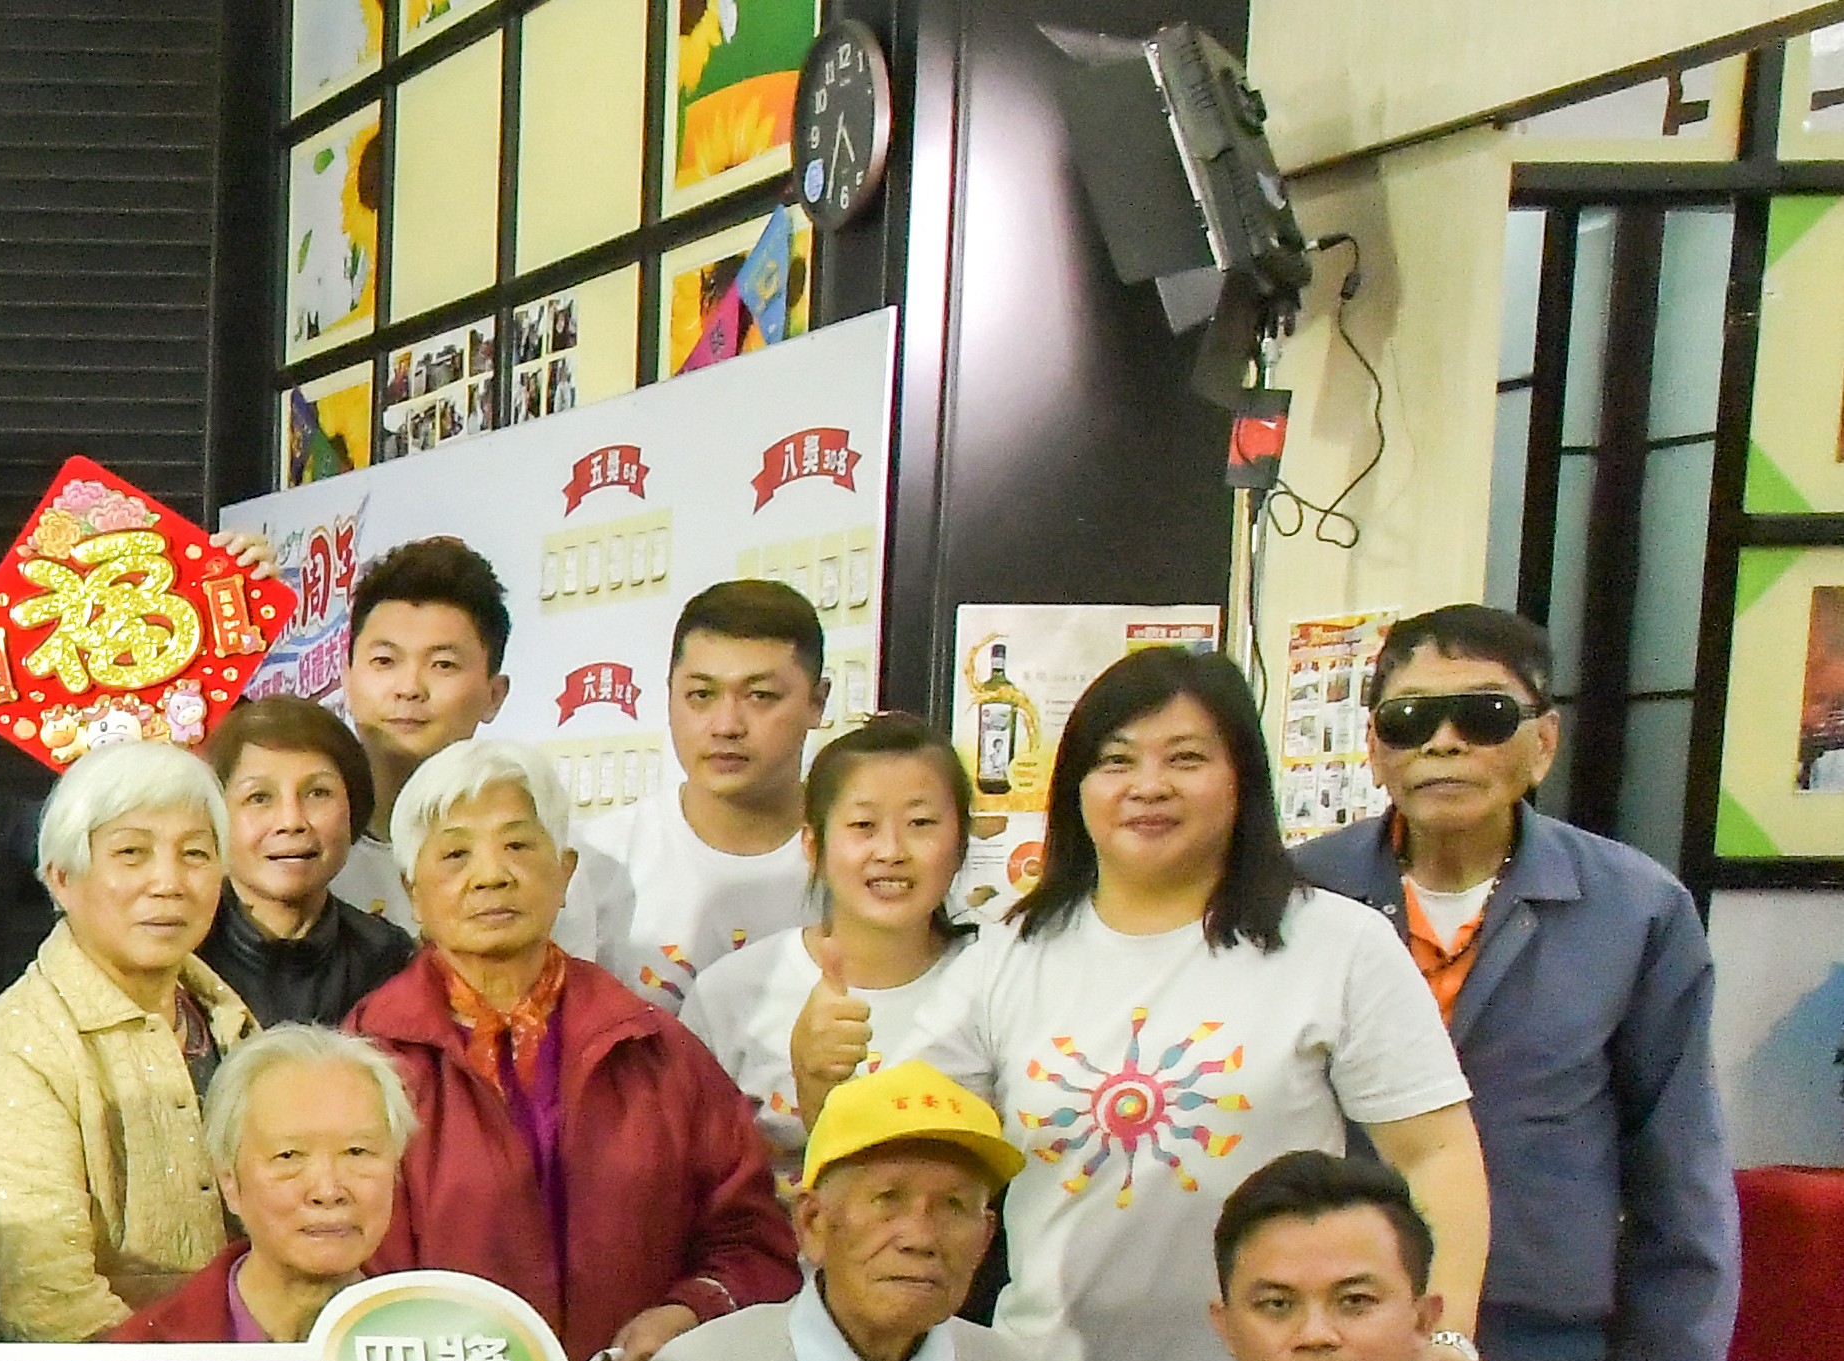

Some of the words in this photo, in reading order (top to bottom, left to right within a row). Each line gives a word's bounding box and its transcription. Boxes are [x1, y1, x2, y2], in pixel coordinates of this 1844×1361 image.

[838, 43, 853, 70] 12
[825, 61, 836, 85] 11
[814, 89, 829, 115] 10
[810, 126, 820, 150] 9
[840, 185, 849, 209] 6
[9, 530, 203, 693] 福
